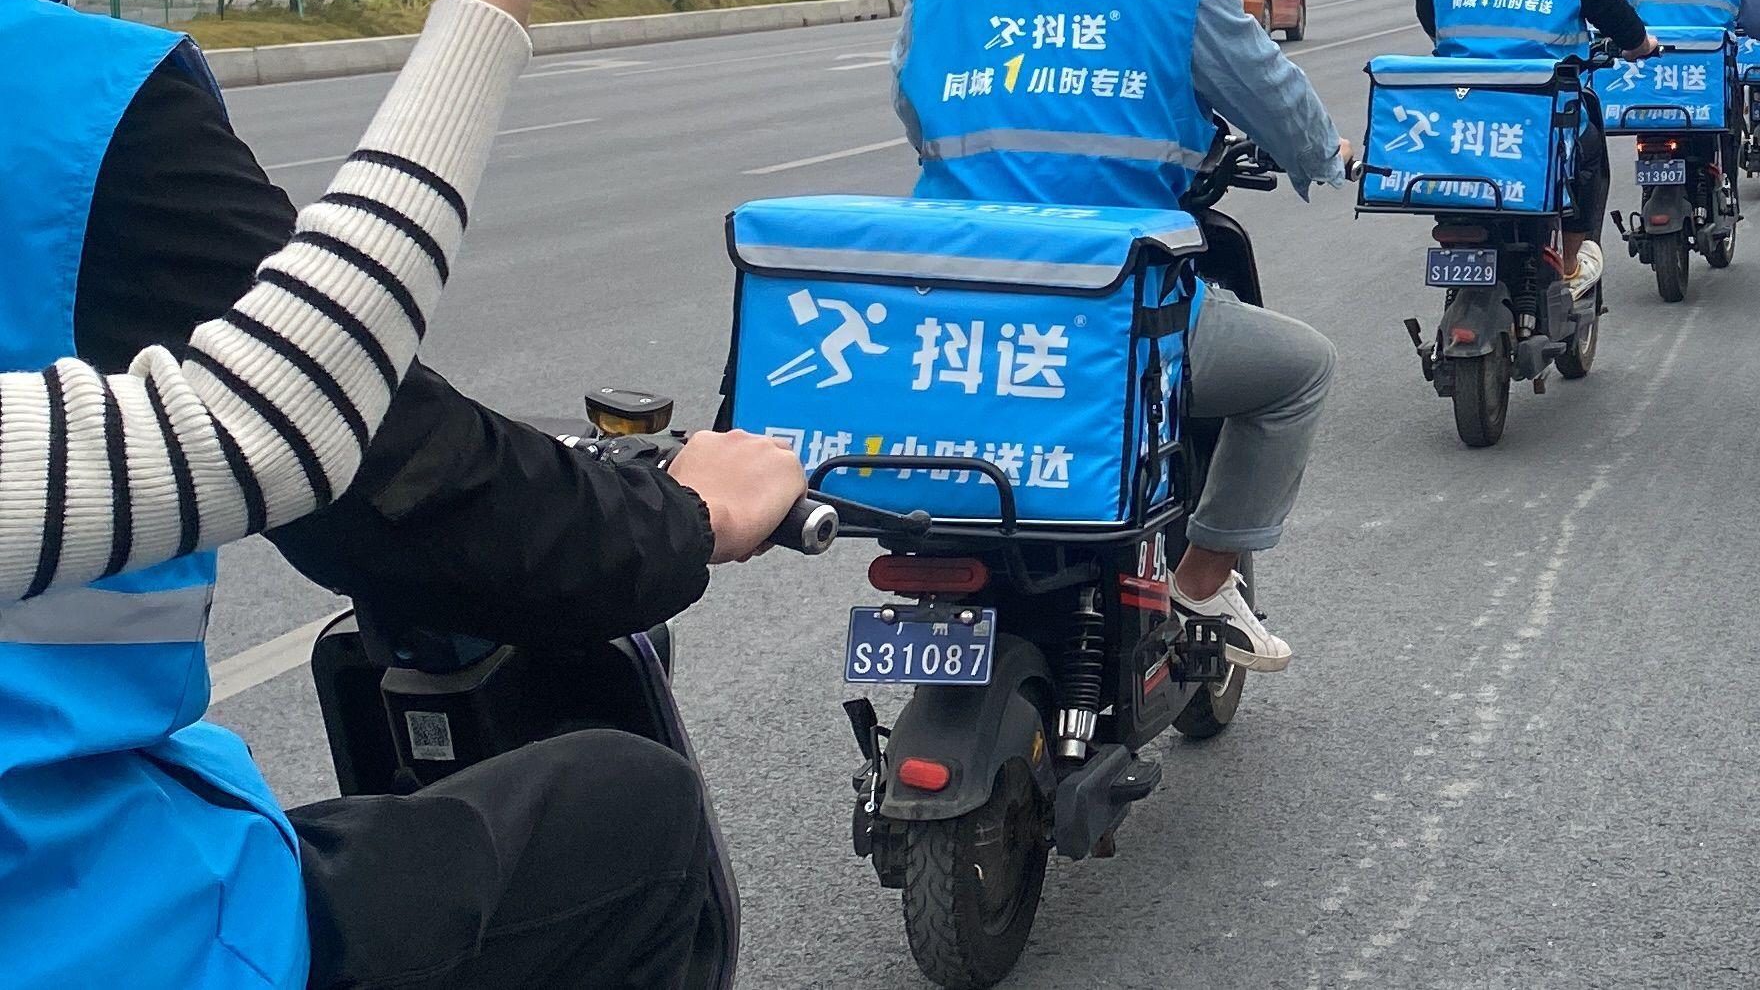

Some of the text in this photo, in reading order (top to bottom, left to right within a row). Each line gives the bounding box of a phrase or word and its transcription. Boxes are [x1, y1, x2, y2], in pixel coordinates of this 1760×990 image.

[942, 53, 1149, 102] 同城1小时专送
[1637, 170, 1684, 183] S13907
[1431, 265, 1494, 282] S12229
[853, 642, 986, 677] S31087
